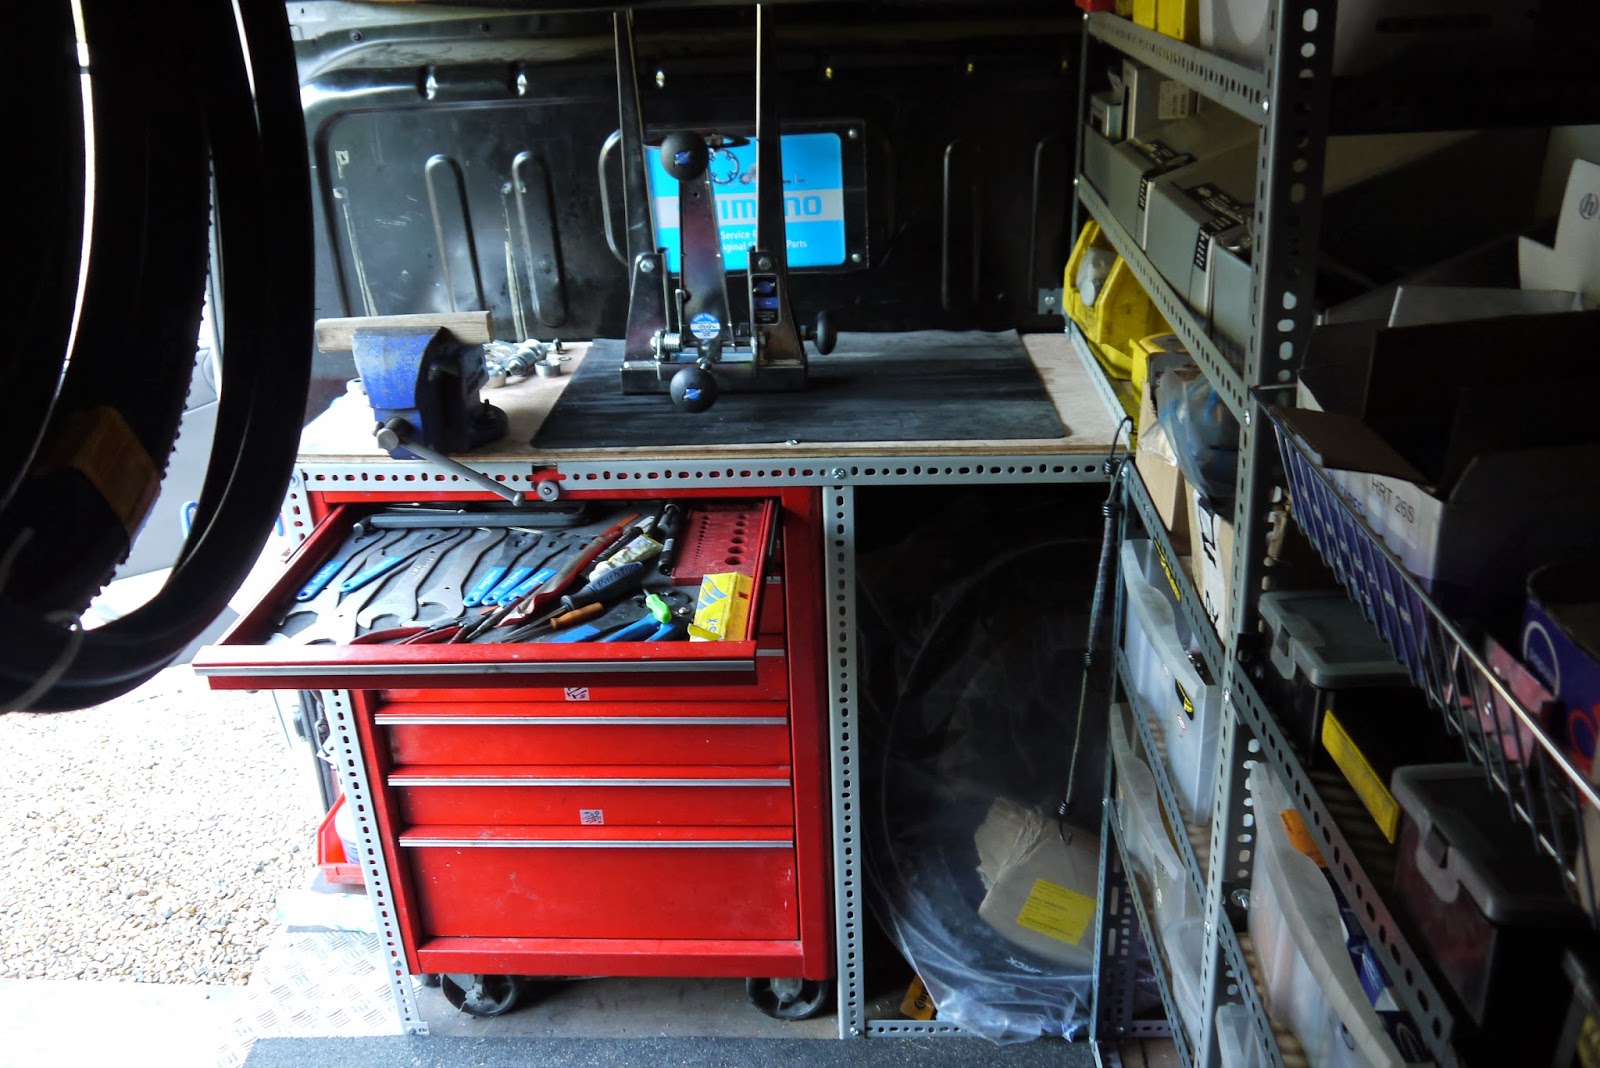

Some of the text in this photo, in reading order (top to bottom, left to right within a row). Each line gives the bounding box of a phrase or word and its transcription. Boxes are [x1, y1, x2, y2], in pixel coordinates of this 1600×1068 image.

[720, 230, 751, 240] Service
[722, 241, 746, 254] iginal
[786, 239, 808, 249] Parts
